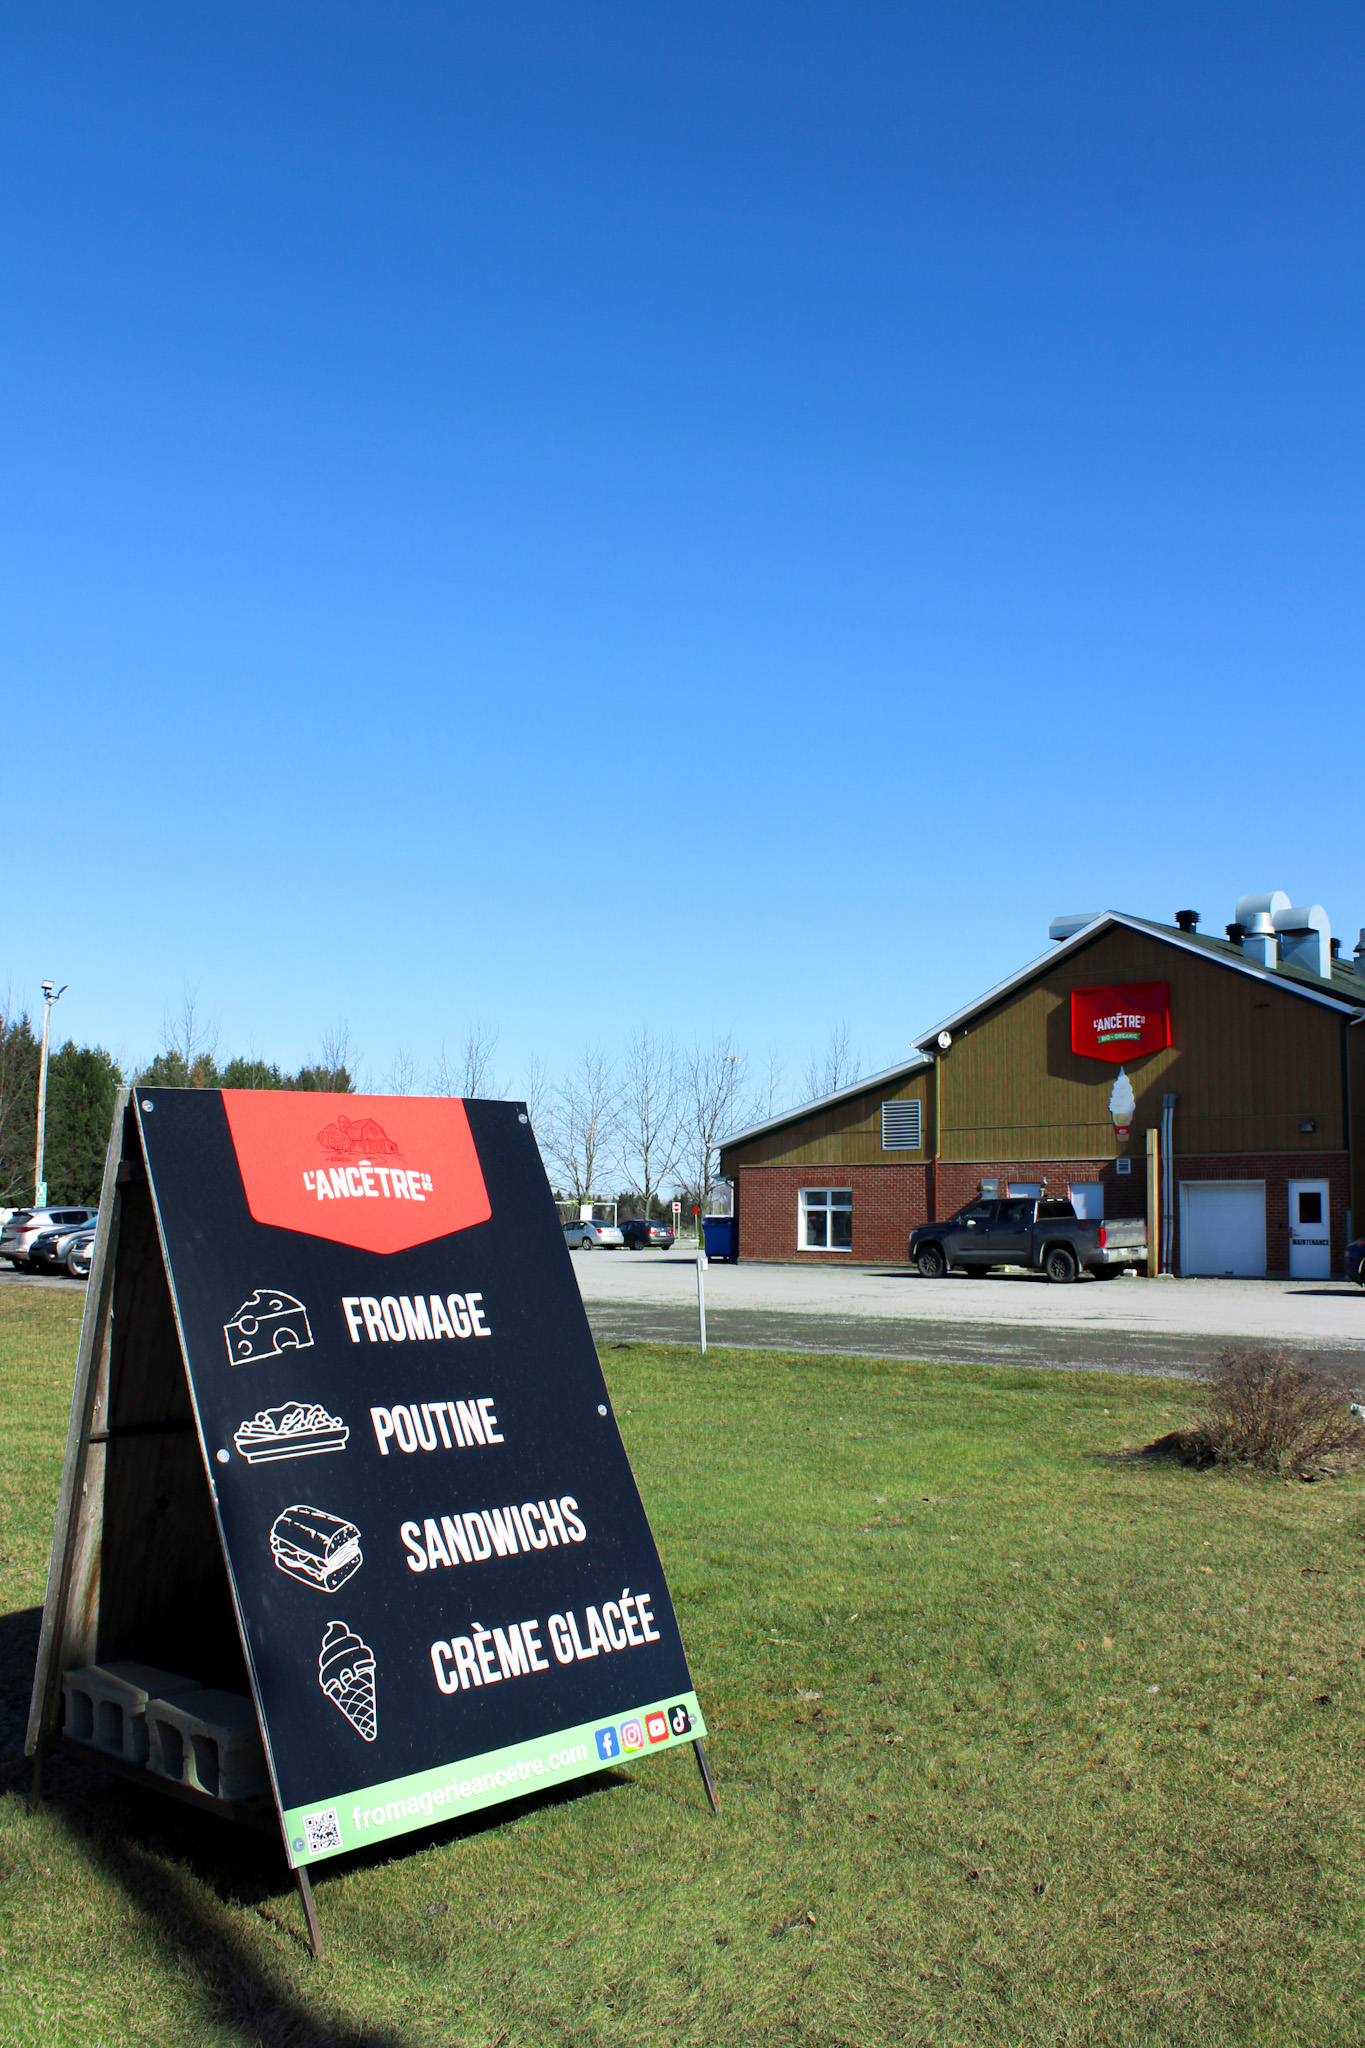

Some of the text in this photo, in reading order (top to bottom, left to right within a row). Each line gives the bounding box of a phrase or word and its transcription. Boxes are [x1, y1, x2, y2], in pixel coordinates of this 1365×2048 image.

[303, 1160, 425, 1201] L'ANCÊTRE
[341, 1292, 492, 1343] FROMAGE
[369, 1397, 505, 1455] POUTINE
[400, 1496, 587, 1573] SANDWICHS
[430, 1588, 661, 1695] CRÈME GLACÉE
[352, 1743, 589, 1832] fromagerieancetre.com
